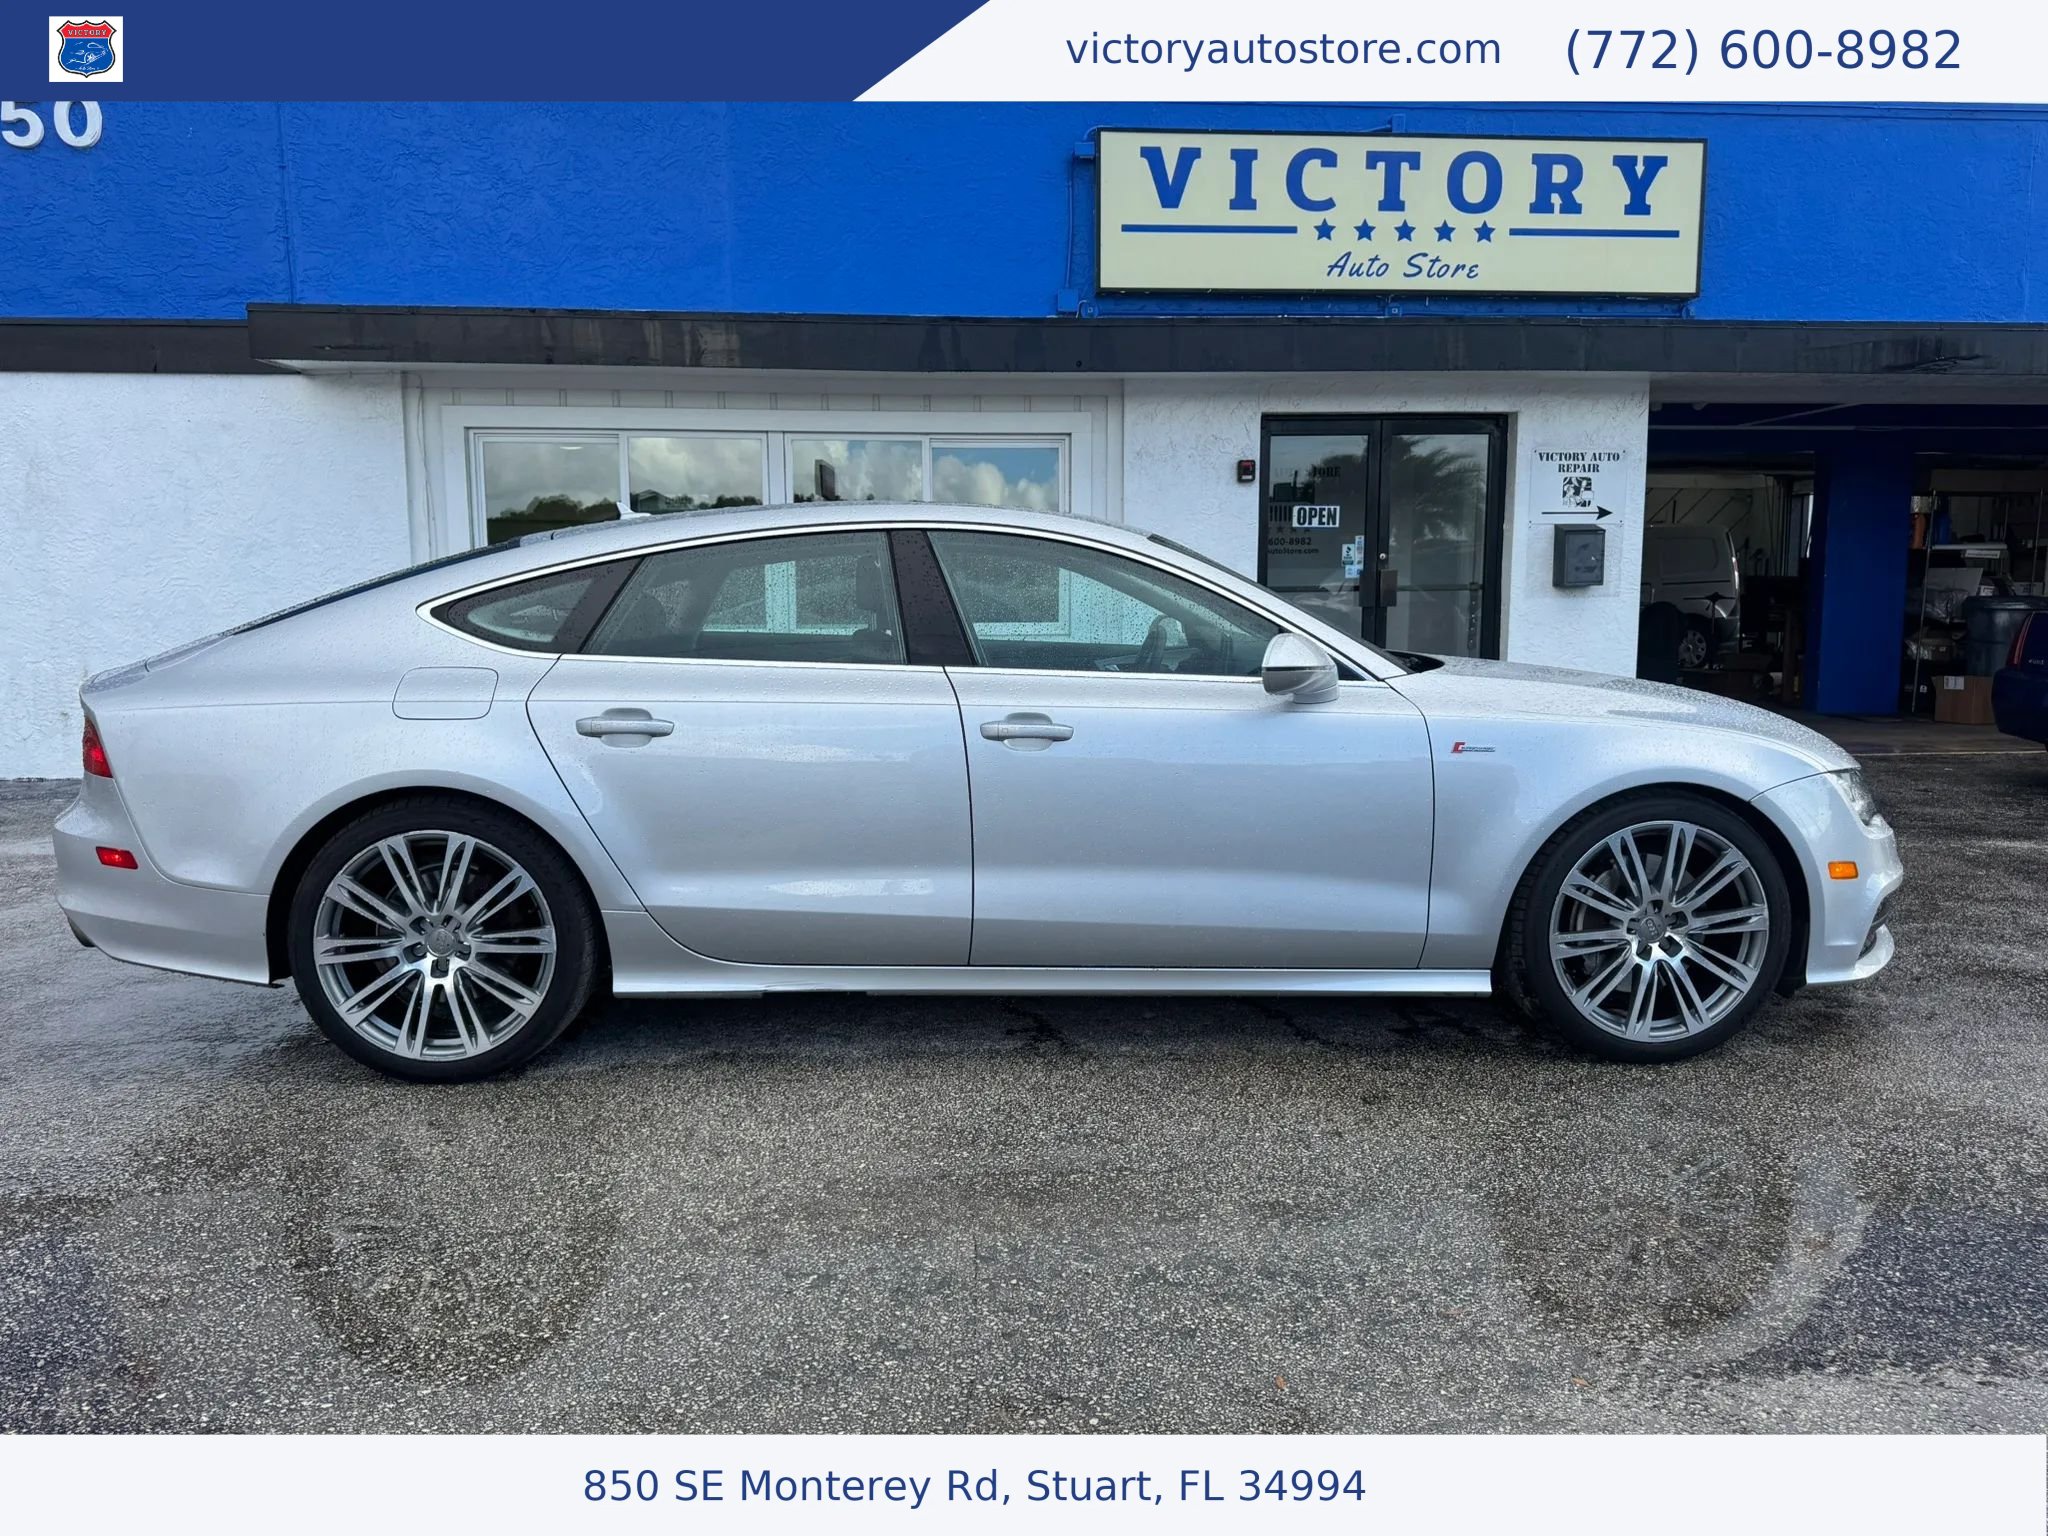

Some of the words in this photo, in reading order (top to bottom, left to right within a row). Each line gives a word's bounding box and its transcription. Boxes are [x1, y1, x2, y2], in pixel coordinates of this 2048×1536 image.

[1140, 146, 1669, 216] VICTORY
[1327, 251, 1390, 278] Auto
[1403, 252, 1480, 279] Store
[1538, 452, 1587, 462] VICTORY
[1590, 452, 1620, 462] AUTO
[1558, 463, 1600, 473] REPAIR
[1297, 507, 1337, 526] OPEN
[1268, 537, 1312, 546] 600-8982
